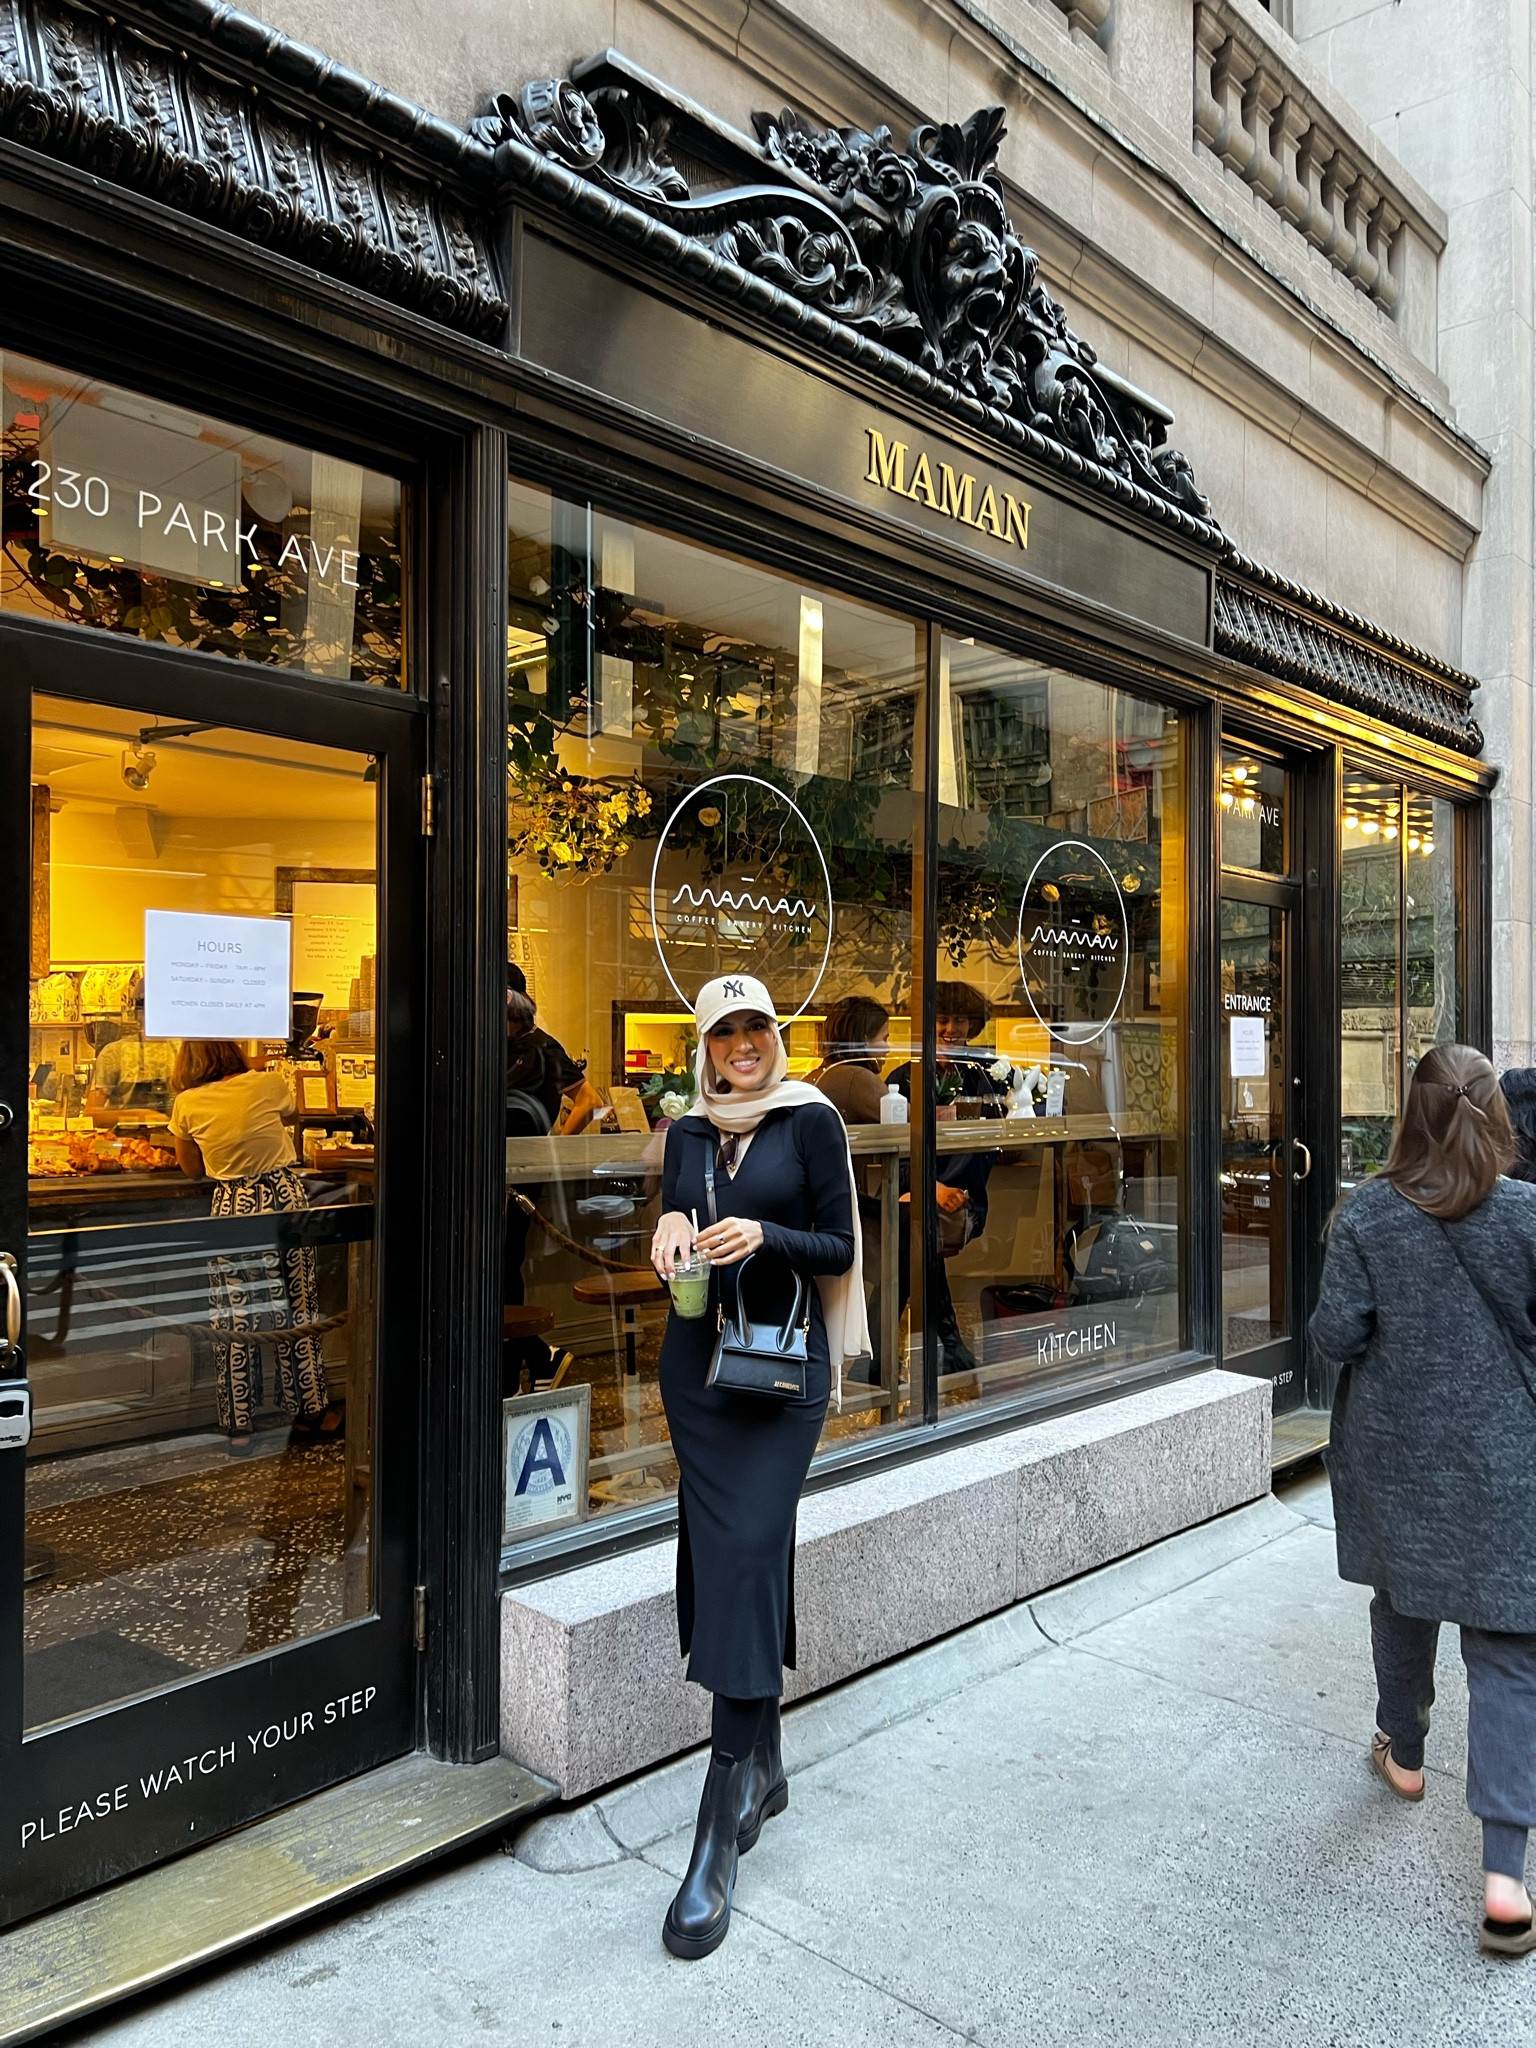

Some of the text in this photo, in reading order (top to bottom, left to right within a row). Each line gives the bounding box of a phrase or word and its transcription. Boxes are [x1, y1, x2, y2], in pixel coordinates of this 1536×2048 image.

[865, 427, 1032, 550] MAMAN
[28, 460, 361, 588] 230 PARK AVE
[1258, 805, 1280, 827] AVE
[773, 923, 812, 934] KITCHEN
[197, 940, 243, 954] HOURS
[171, 961, 198, 969] MONDAY
[171, 975, 203, 983] SATURDAY
[723, 980, 745, 998] NY
[1224, 994, 1272, 1012] ENTRANCE
[1037, 1321, 1116, 1365] KITCHEN
[1278, 1370, 1294, 1385] STEP
[514, 1418, 567, 1497] A
[21, 1686, 376, 1849] PLEASE WATCH YOUR STEP
